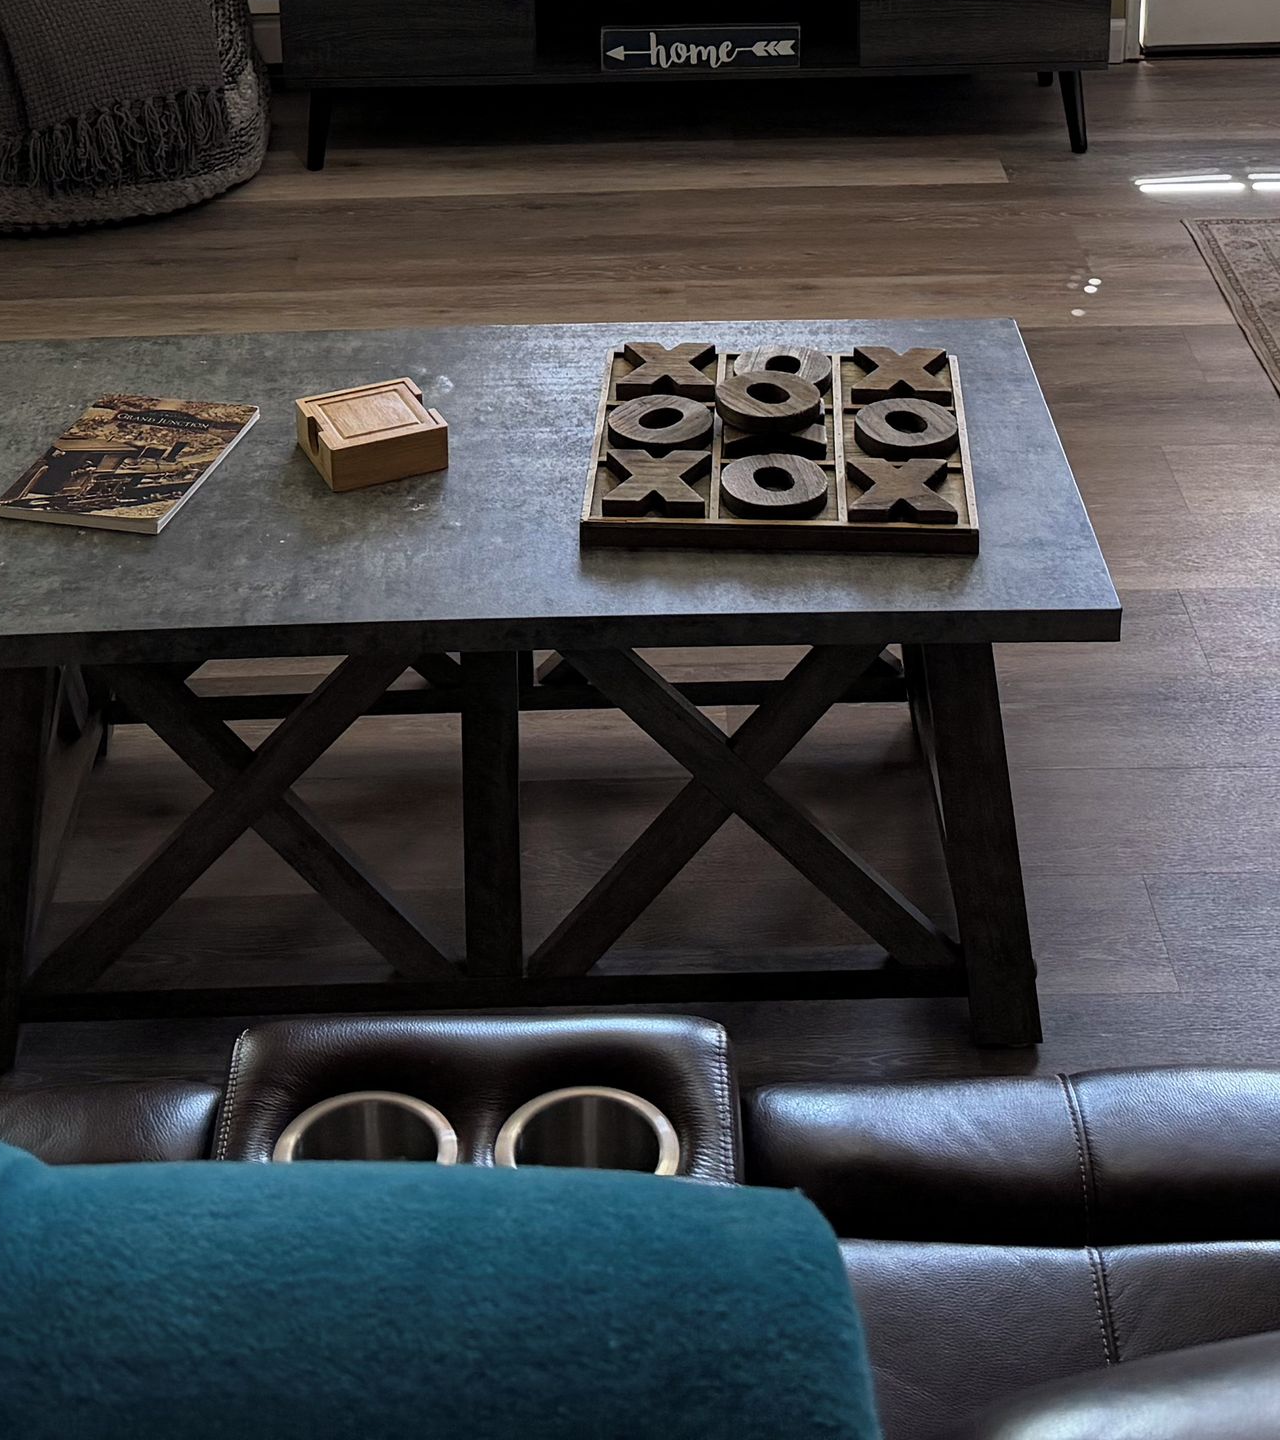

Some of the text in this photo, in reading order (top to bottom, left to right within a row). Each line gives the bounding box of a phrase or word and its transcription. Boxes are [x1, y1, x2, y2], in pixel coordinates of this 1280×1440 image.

[649, 31, 737, 69] home
[117, 412, 156, 425] GRAND
[157, 417, 210, 429] JUNCTION
